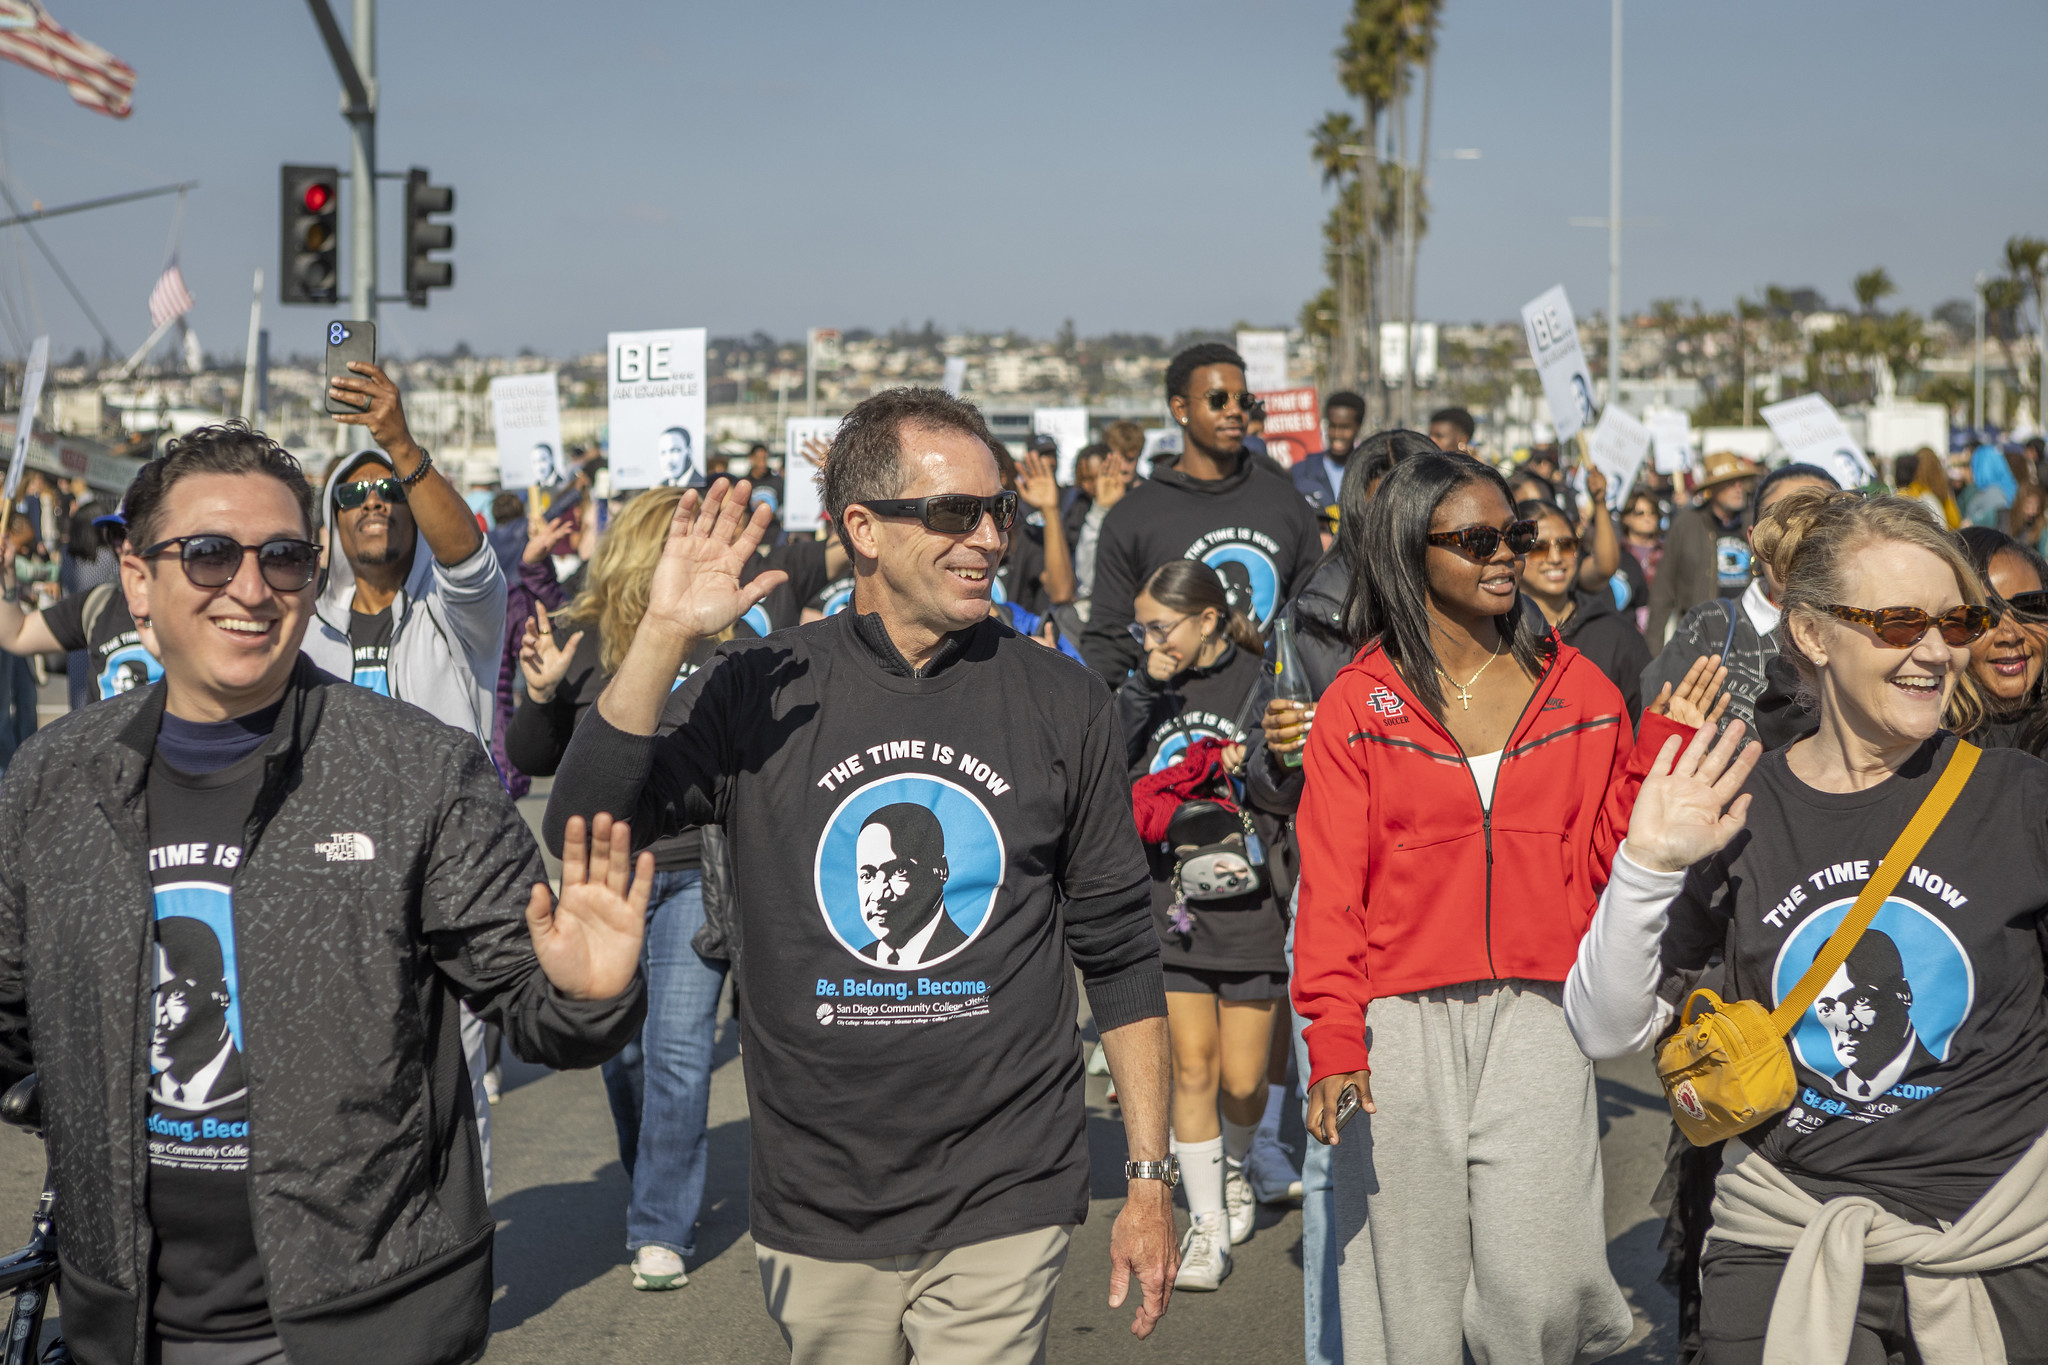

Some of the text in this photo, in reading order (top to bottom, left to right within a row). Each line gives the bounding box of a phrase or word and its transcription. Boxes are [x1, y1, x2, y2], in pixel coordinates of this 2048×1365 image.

[634, 383, 697, 399] EXAMPLE
[1184, 527, 1280, 560] THE TIME IS NOW
[1203, 712, 1218, 726] IS
[1383, 716, 1409, 726] SOCCER
[817, 740, 1011, 797] THE TIME IS NOW
[331, 832, 353, 844] THE
[314, 842, 353, 853] NORTH
[326, 851, 354, 861] FACE
[212, 844, 242, 869] IS
[1762, 860, 1870, 929] THE TIME
[1907, 865, 1969, 909] NOW
[816, 978, 839, 996] Be.
[843, 979, 913, 1001] Belong.
[836, 1004, 851, 1014] San
[852, 1004, 879, 1016] Diego
[880, 1002, 931, 1015] Community
[166, 1141, 220, 1159] Community
